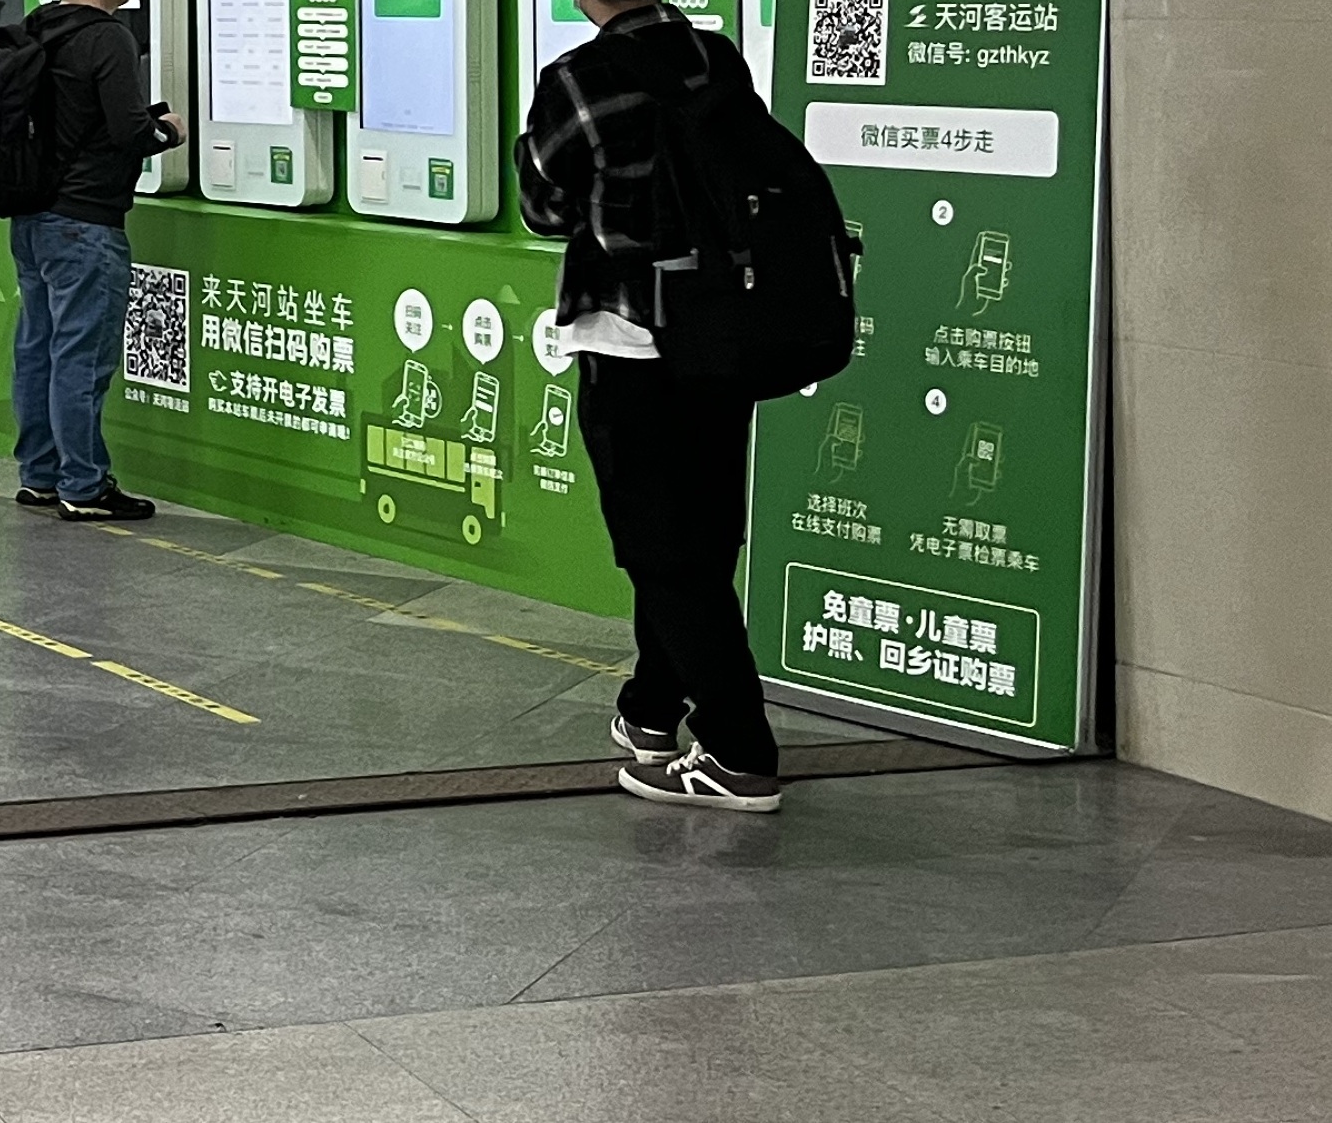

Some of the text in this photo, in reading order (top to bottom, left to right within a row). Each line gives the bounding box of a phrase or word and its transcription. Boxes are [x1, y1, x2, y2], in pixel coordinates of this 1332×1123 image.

[934, 2, 1059, 32] 天河客运站
[977, 45, 1051, 69] gzthkyz
[860, 124, 995, 154] 微信买票4步走
[201, 273, 354, 331] 来天河站坐车
[201, 314, 355, 374] 用微信扫码购票
[934, 325, 1032, 354] 点击购票按钮
[925, 347, 1040, 378] 输入乘车目的地
[230, 370, 347, 419] 支持开电子发票
[807, 493, 868, 520] 选择班次
[791, 512, 882, 545] 在线支付购票
[942, 515, 1007, 544] 无需取票
[909, 532, 1040, 573] 凭电子票检票乘车
[822, 589, 997, 655] 免童票·儿童票
